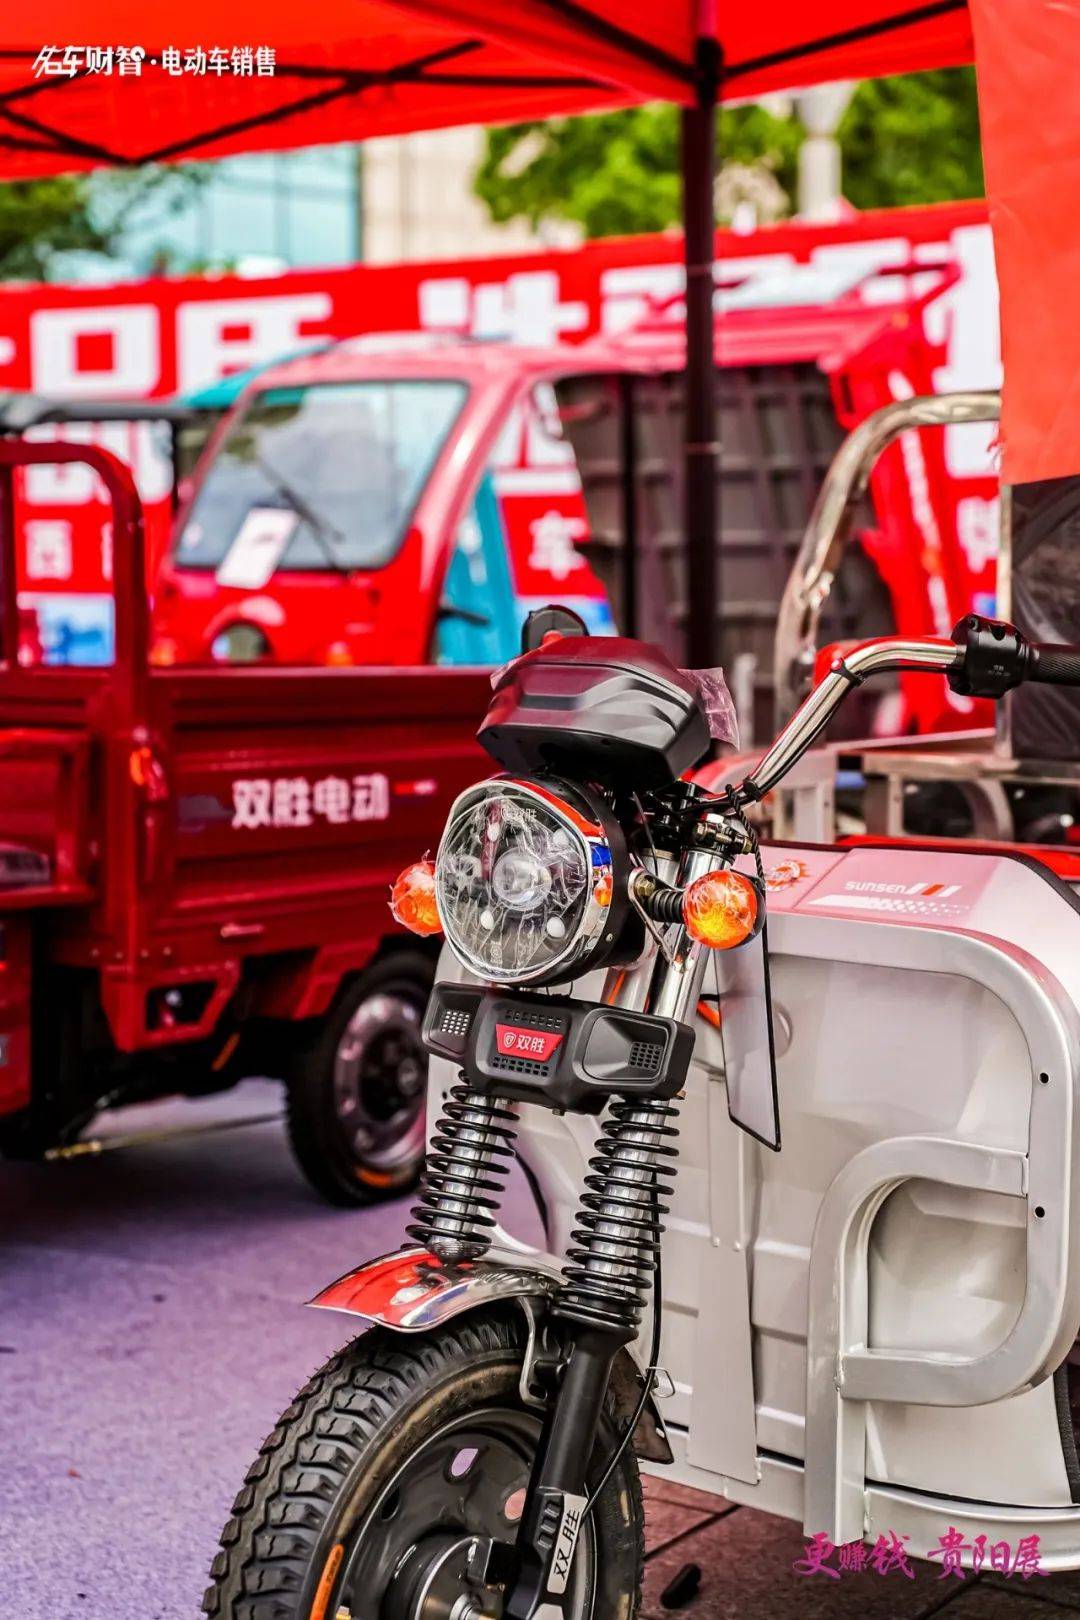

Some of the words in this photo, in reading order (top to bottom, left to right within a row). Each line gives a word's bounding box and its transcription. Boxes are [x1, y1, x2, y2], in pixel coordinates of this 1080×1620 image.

[231, 772, 389, 829] 双胜电动
[516, 1034, 545, 1054] 双胜
[553, 1509, 580, 1581] 双胜
